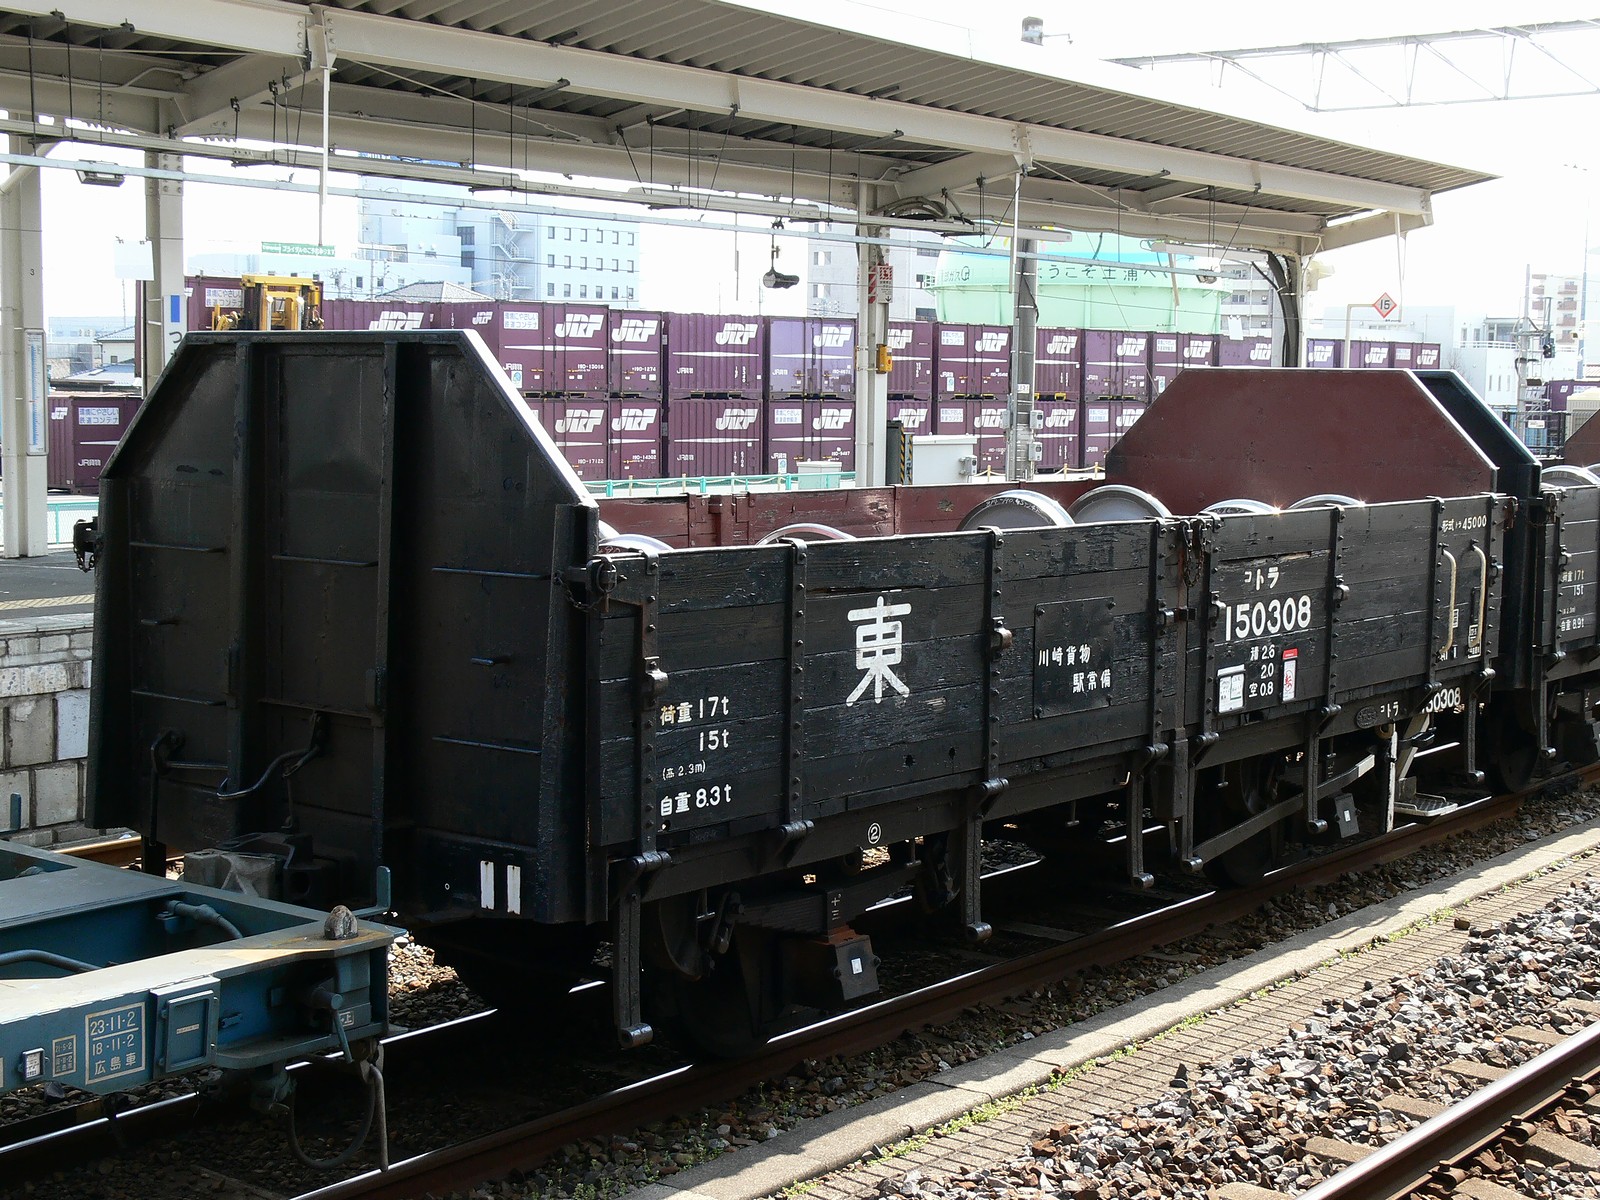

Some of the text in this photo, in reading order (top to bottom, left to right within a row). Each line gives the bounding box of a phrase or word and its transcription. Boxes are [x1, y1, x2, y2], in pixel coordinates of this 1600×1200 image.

[554, 313, 604, 338] JRF
[611, 319, 659, 343] JRF
[715, 322, 758, 345] JRF
[813, 326, 853, 348] JRF
[975, 332, 1009, 352] JRF
[1046, 335, 1078, 355] JRF
[1116, 337, 1147, 357] JRF
[1183, 340, 1212, 359] JRF
[1308, 345, 1335, 363] JRF
[1364, 347, 1389, 364] JRF
[1416, 349, 1438, 366] JRF
[554, 409, 604, 433] JRF
[611, 408, 657, 431] JRF
[715, 408, 758, 430] JRF
[812, 408, 852, 430] JRF
[1045, 408, 1076, 428] JRF
[1226, 595, 1311, 641] 150308
[846, 596, 911, 706] 東
[1038, 643, 1091, 667] 川崎貨物
[1072, 668, 1111, 693] 駅常備
[1261, 662, 1274, 679] 2.0
[1260, 681, 1274, 697] 0.8
[660, 701, 693, 726] 荷重
[699, 729, 729, 752] 15t
[660, 791, 691, 817] 自重
[94, 1052, 136, 1076] 広島車
